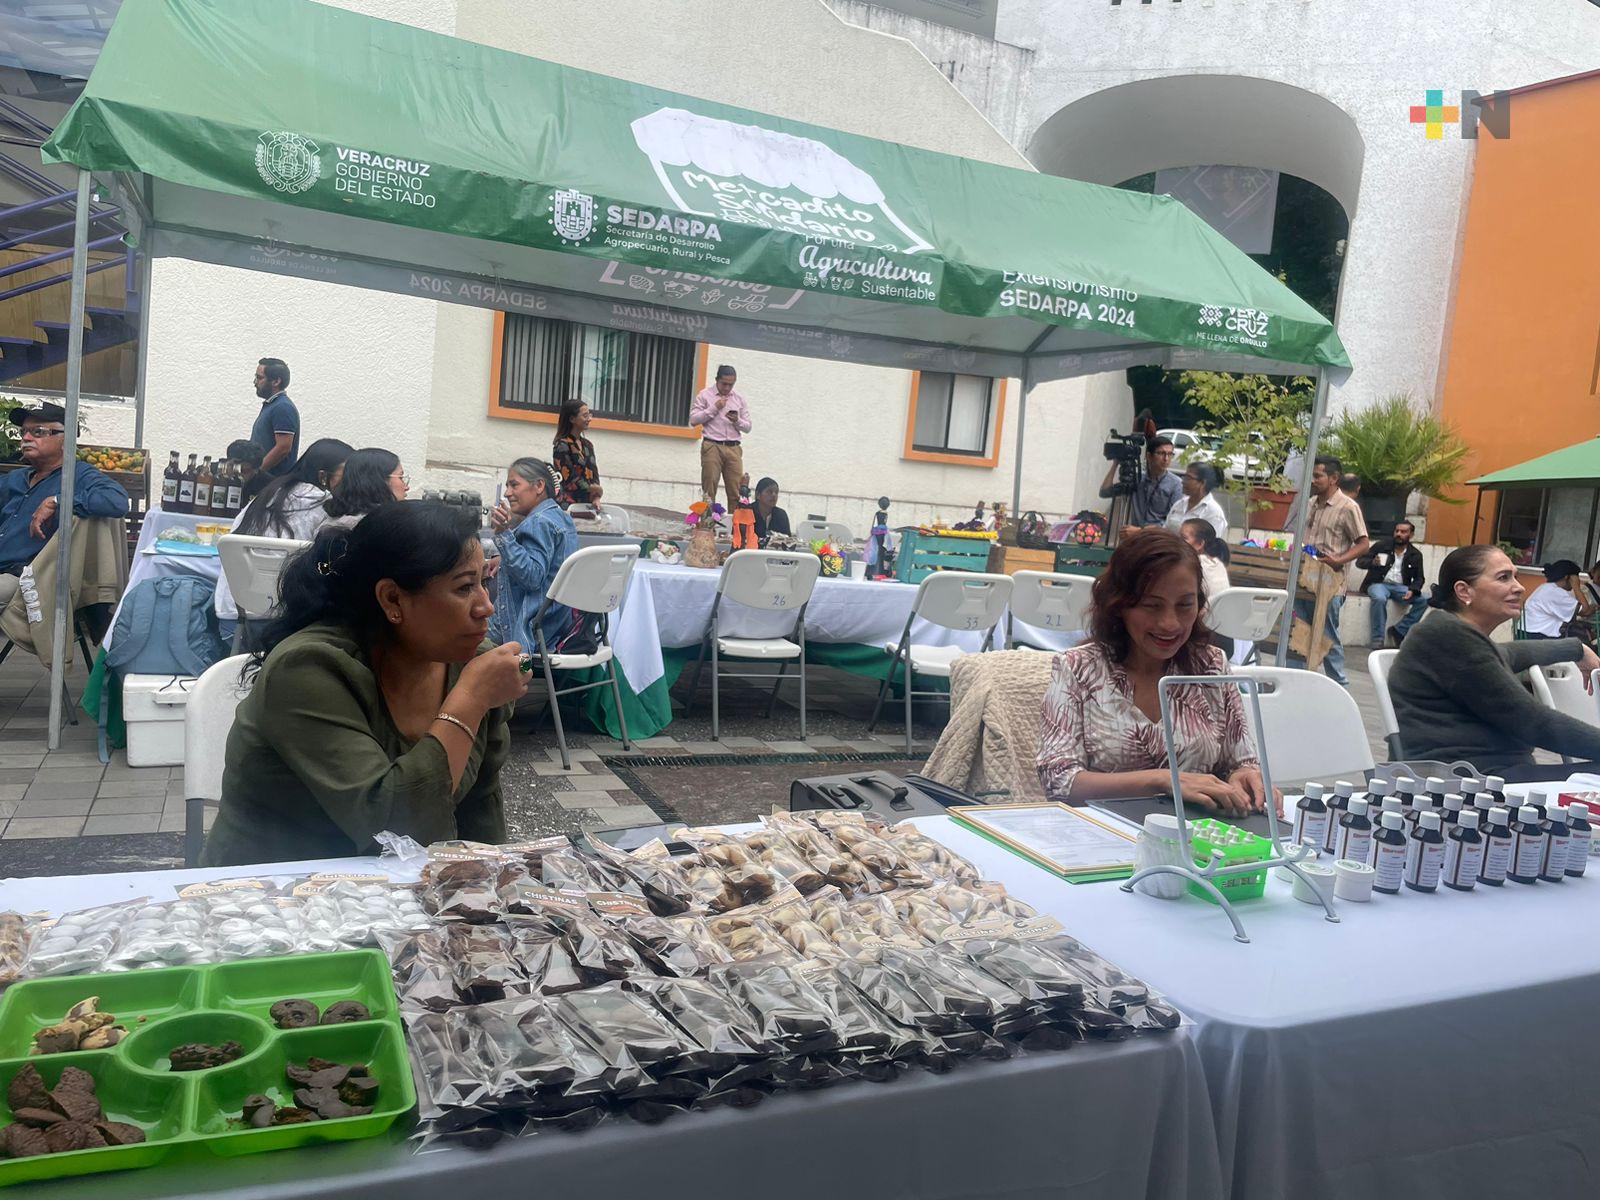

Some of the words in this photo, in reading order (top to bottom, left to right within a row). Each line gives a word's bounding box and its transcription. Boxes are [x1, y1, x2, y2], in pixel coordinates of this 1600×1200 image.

[336, 147, 431, 177] VERACRUZ
[336, 162, 423, 191] GOBIERNO
[335, 177, 367, 196] DEL
[371, 185, 436, 208] ESTADO
[682, 170, 875, 224] Mercadito
[606, 204, 722, 242] SEDARPA
[712, 192, 876, 243] Solidario
[604, 236, 671, 255] Agropecuario,
[672, 247, 697, 258] Rural
[705, 253, 731, 265] Pesca
[606, 224, 654, 241] Secretaría
[655, 233, 668, 243] de
[669, 235, 715, 251] Desarrollo
[798, 245, 934, 287] Agricultura
[861, 280, 936, 301] Sustentable
[1000, 289, 1093, 321] SEDARPA
[1097, 303, 1136, 328] 2024
[1229, 307, 1269, 322] VERA
[1225, 317, 1268, 338] CRUZ
[524, 891, 578, 905] CHISTINAS
